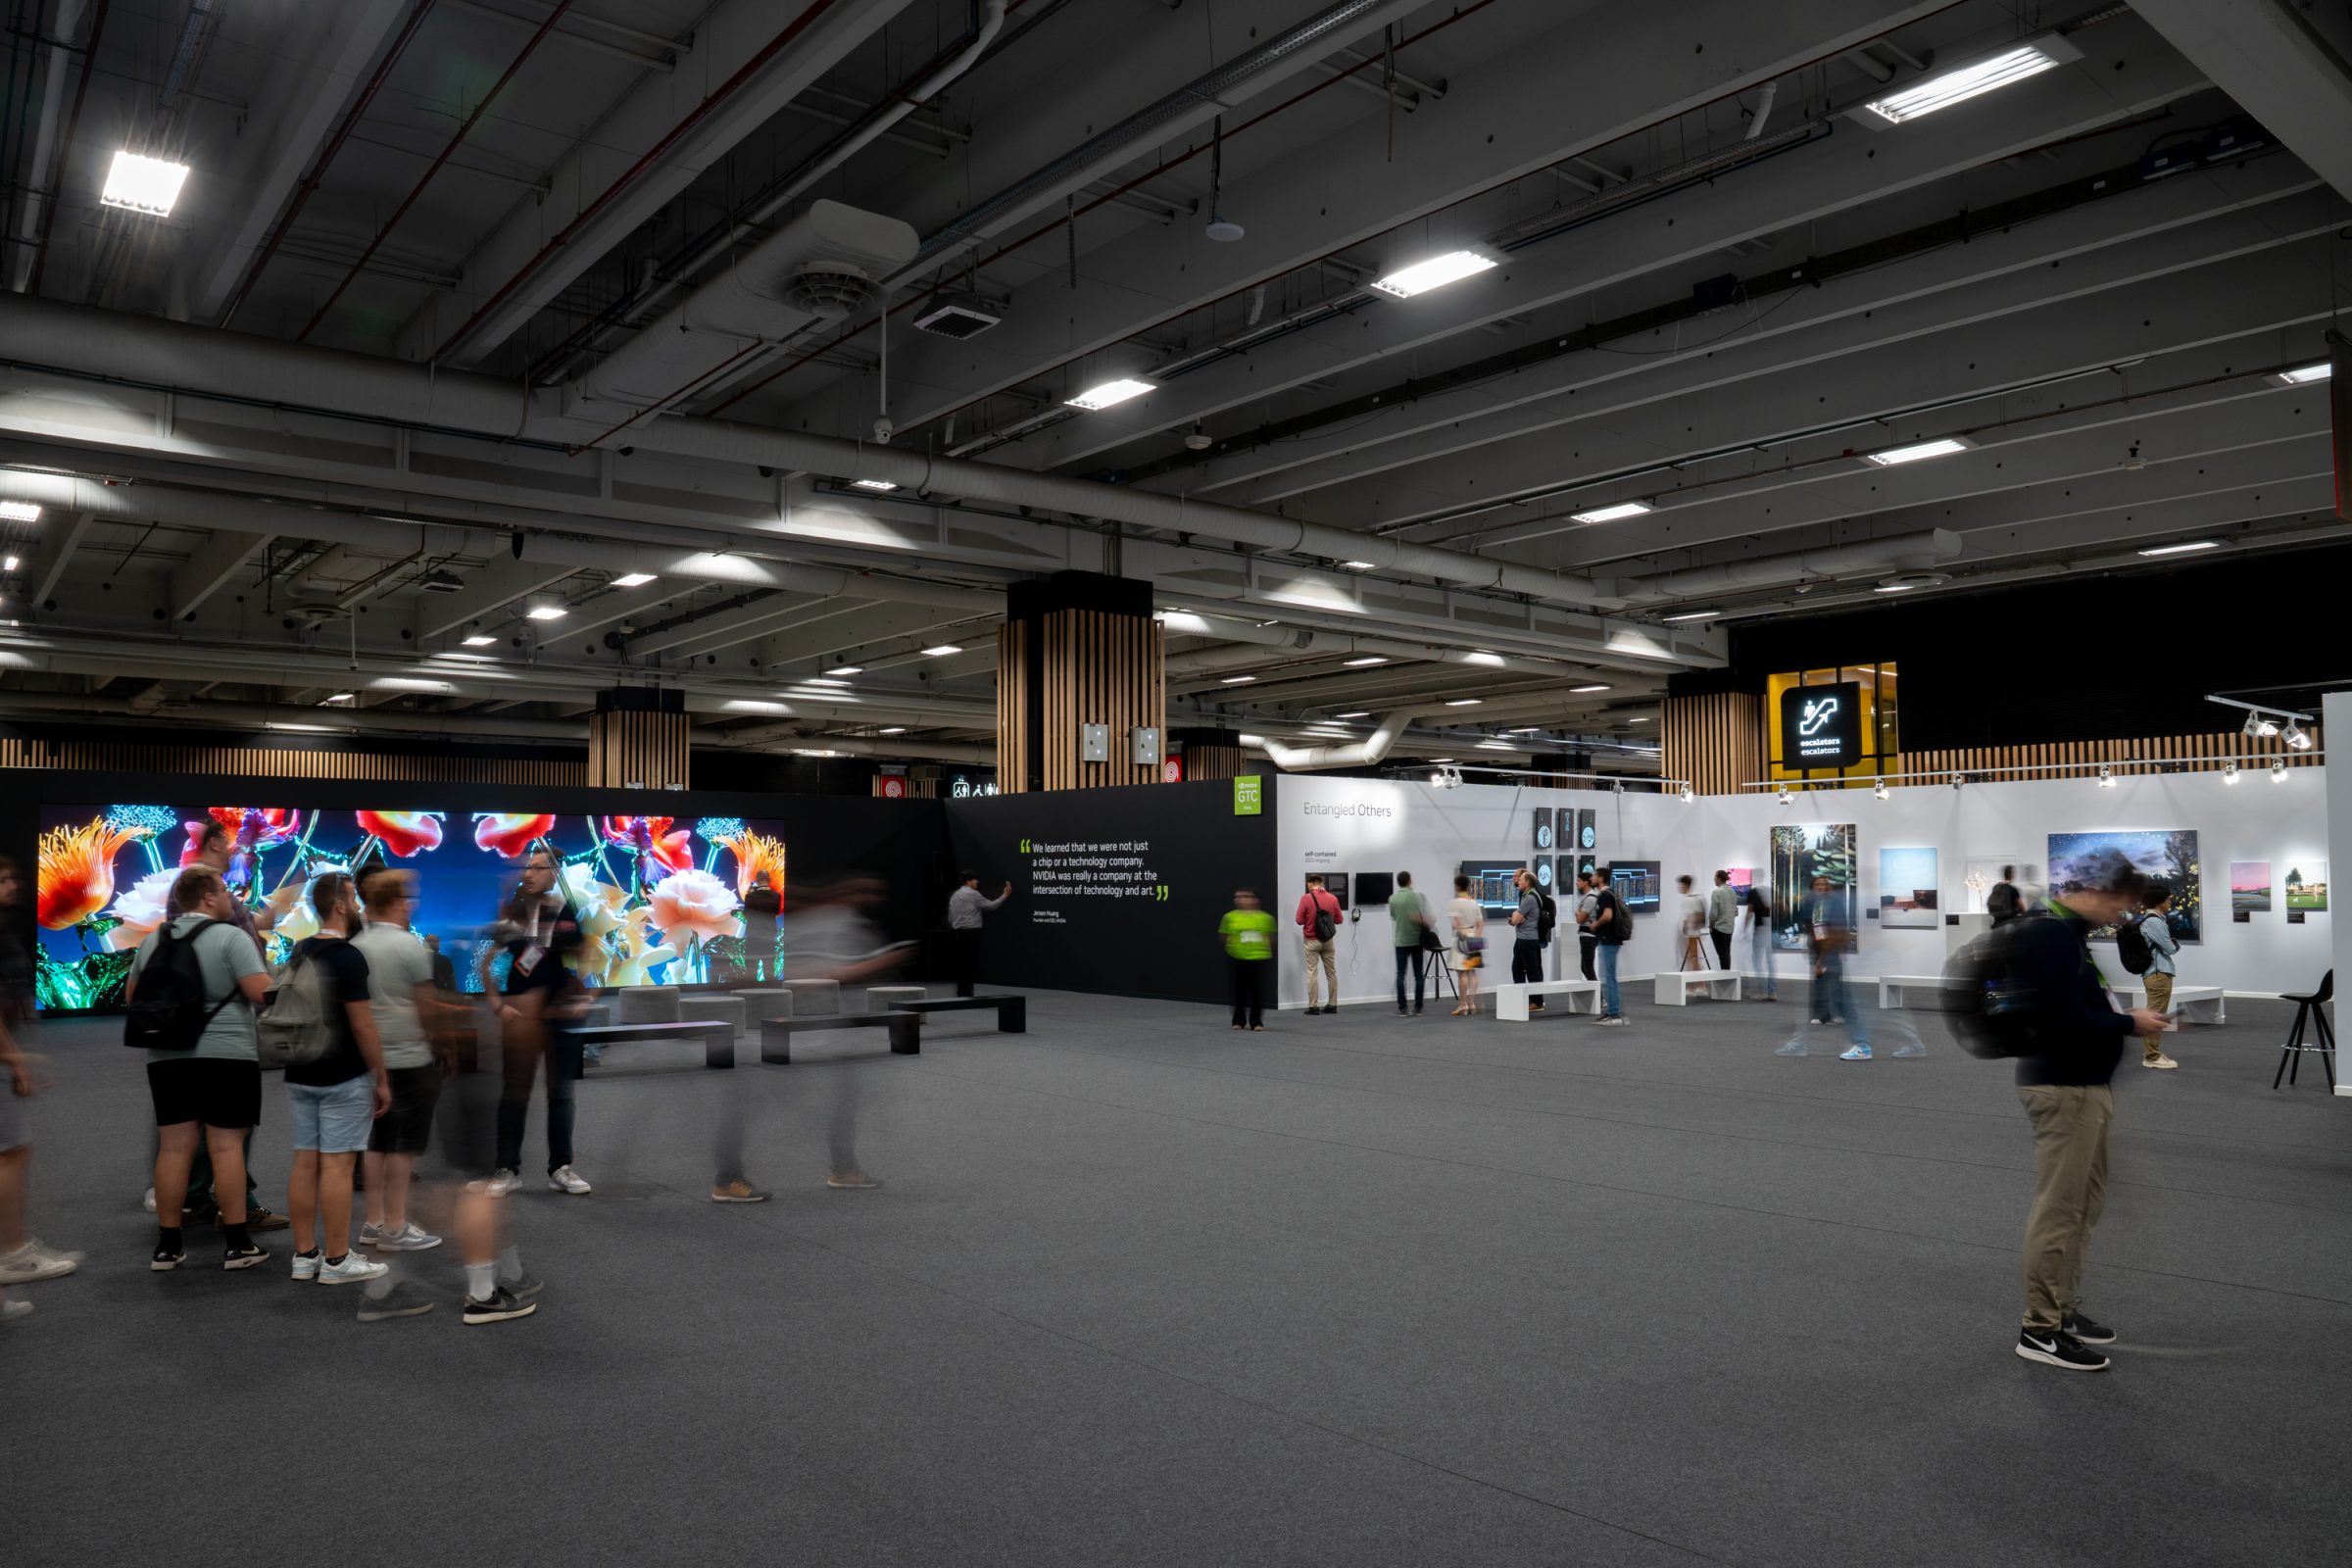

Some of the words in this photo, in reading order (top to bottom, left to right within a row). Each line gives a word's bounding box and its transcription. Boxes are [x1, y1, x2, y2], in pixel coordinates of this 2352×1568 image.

[1238, 790, 1258, 803] GTC
[1303, 802, 1355, 819] Entangled
[1357, 804, 1392, 817] Others
[1033, 843, 1044, 853] We
[1045, 842, 1070, 853] learned
[1071, 842, 1086, 853] that
[1100, 843, 1117, 852] were
[1119, 841, 1132, 851] not
[1133, 840, 1149, 854] just
[1033, 858, 1038, 867] a
[1038, 857, 1053, 868] chip
[1054, 858, 1061, 867] or
[1068, 856, 1107, 868] technology
[1108, 857, 1145, 868] company.
[1033, 870, 1056, 881] NVIDIA
[1057, 872, 1072, 881] was
[1072, 869, 1092, 883] really
[1093, 871, 1098, 880] a
[1099, 871, 1133, 883] company
[1134, 870, 1143, 881] at
[1144, 870, 1157, 881] the
[1033, 884, 1073, 895] intersection
[1074, 884, 1083, 895] of
[1084, 884, 1123, 898] technology
[1125, 884, 1140, 896] and
[1141, 885, 1155, 896] art.
